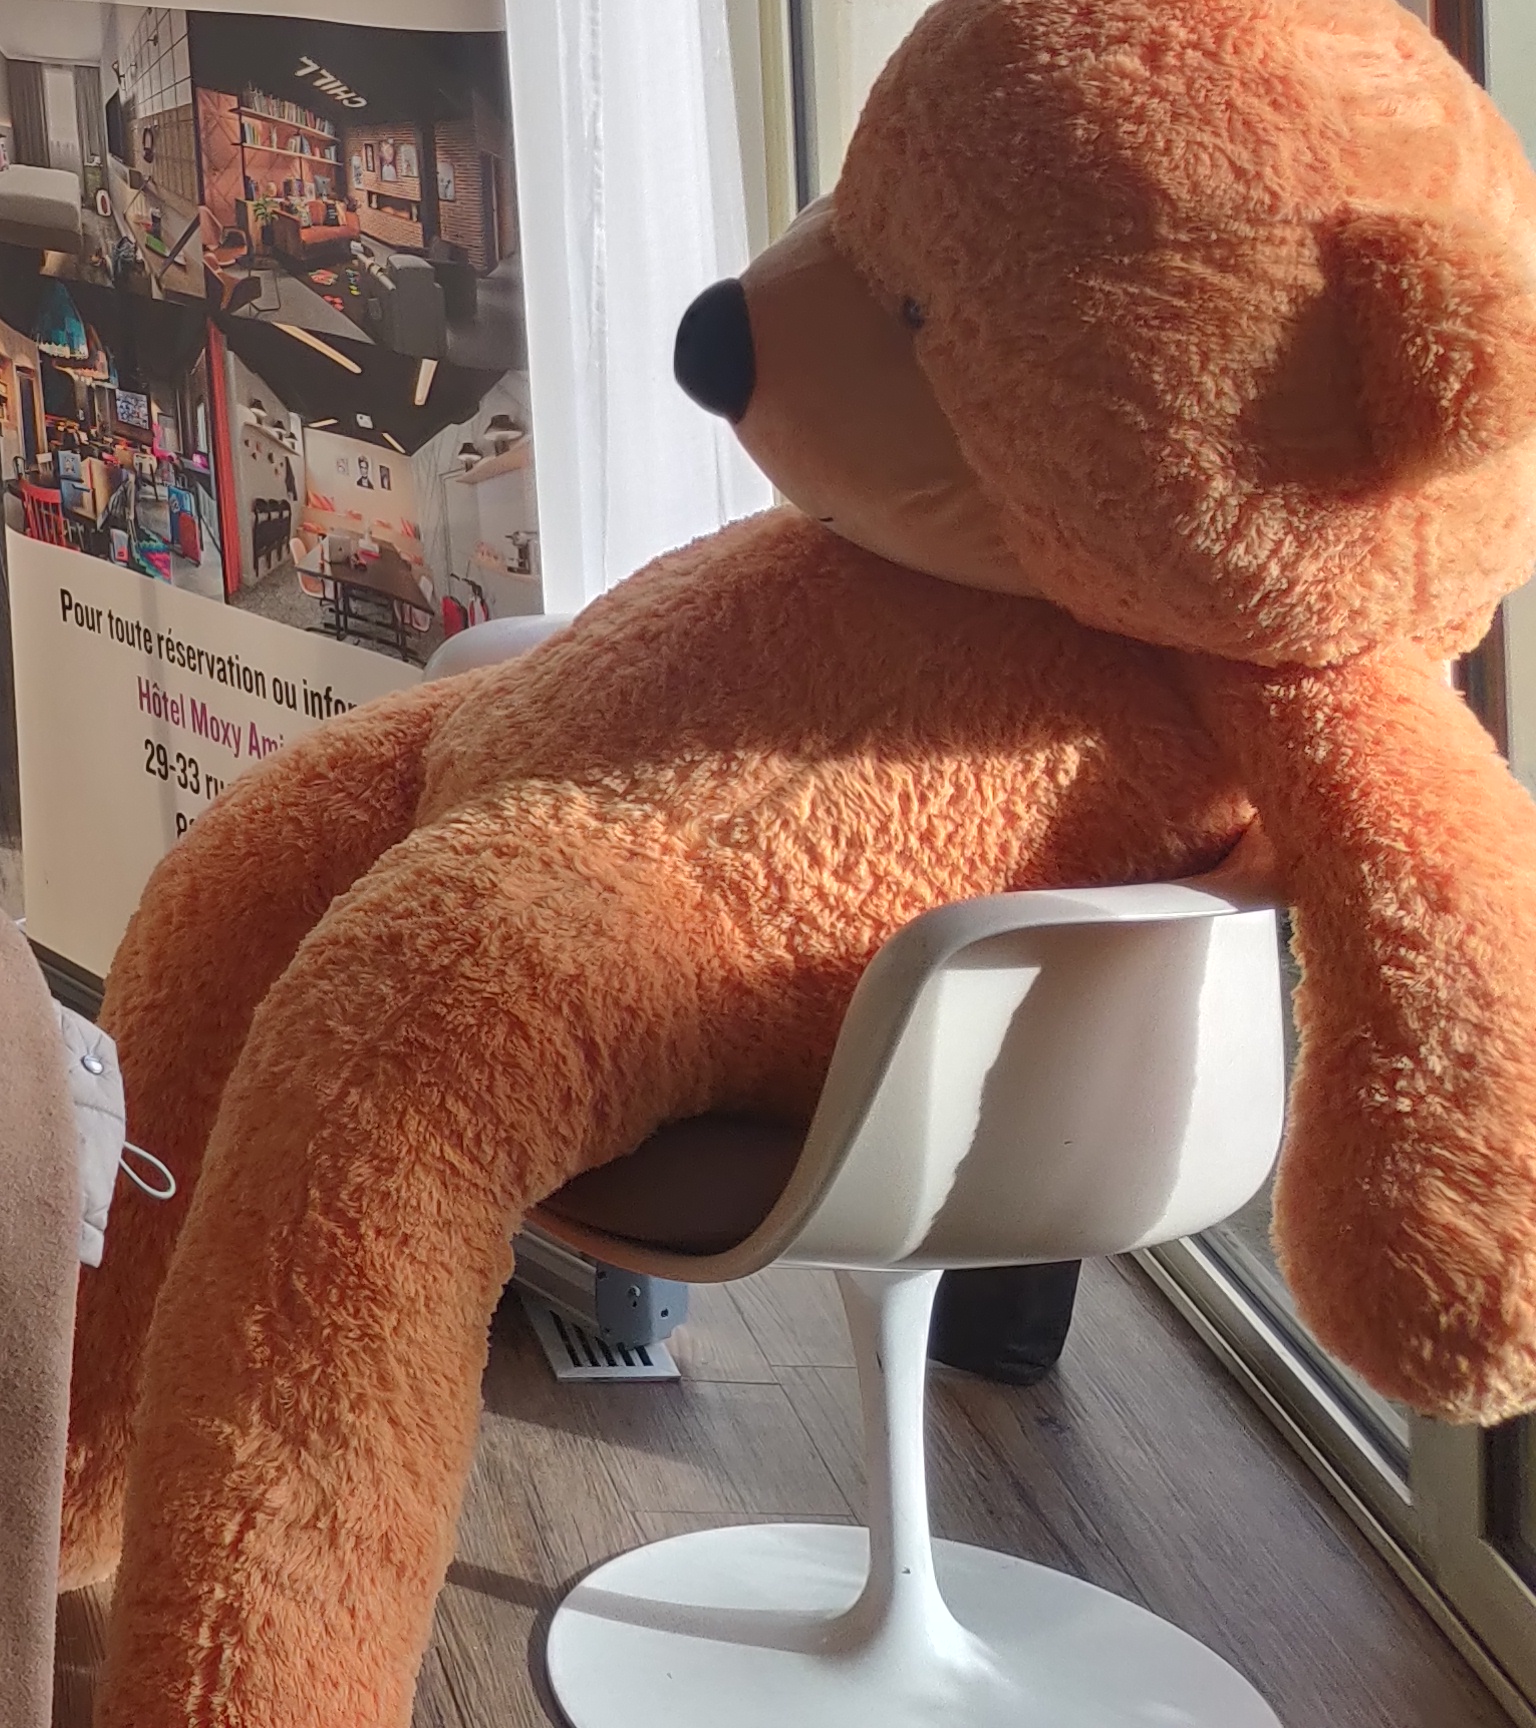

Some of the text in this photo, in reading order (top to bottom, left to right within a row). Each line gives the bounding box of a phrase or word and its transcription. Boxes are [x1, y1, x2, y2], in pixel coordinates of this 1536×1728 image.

[59, 588, 103, 635] Pour
[108, 608, 153, 655] toute
[157, 627, 267, 700] réservation
[272, 676, 297, 712] ou
[137, 675, 186, 729] Hôtel
[190, 696, 242, 758] Moxy
[144, 738, 200, 795] 29-33
